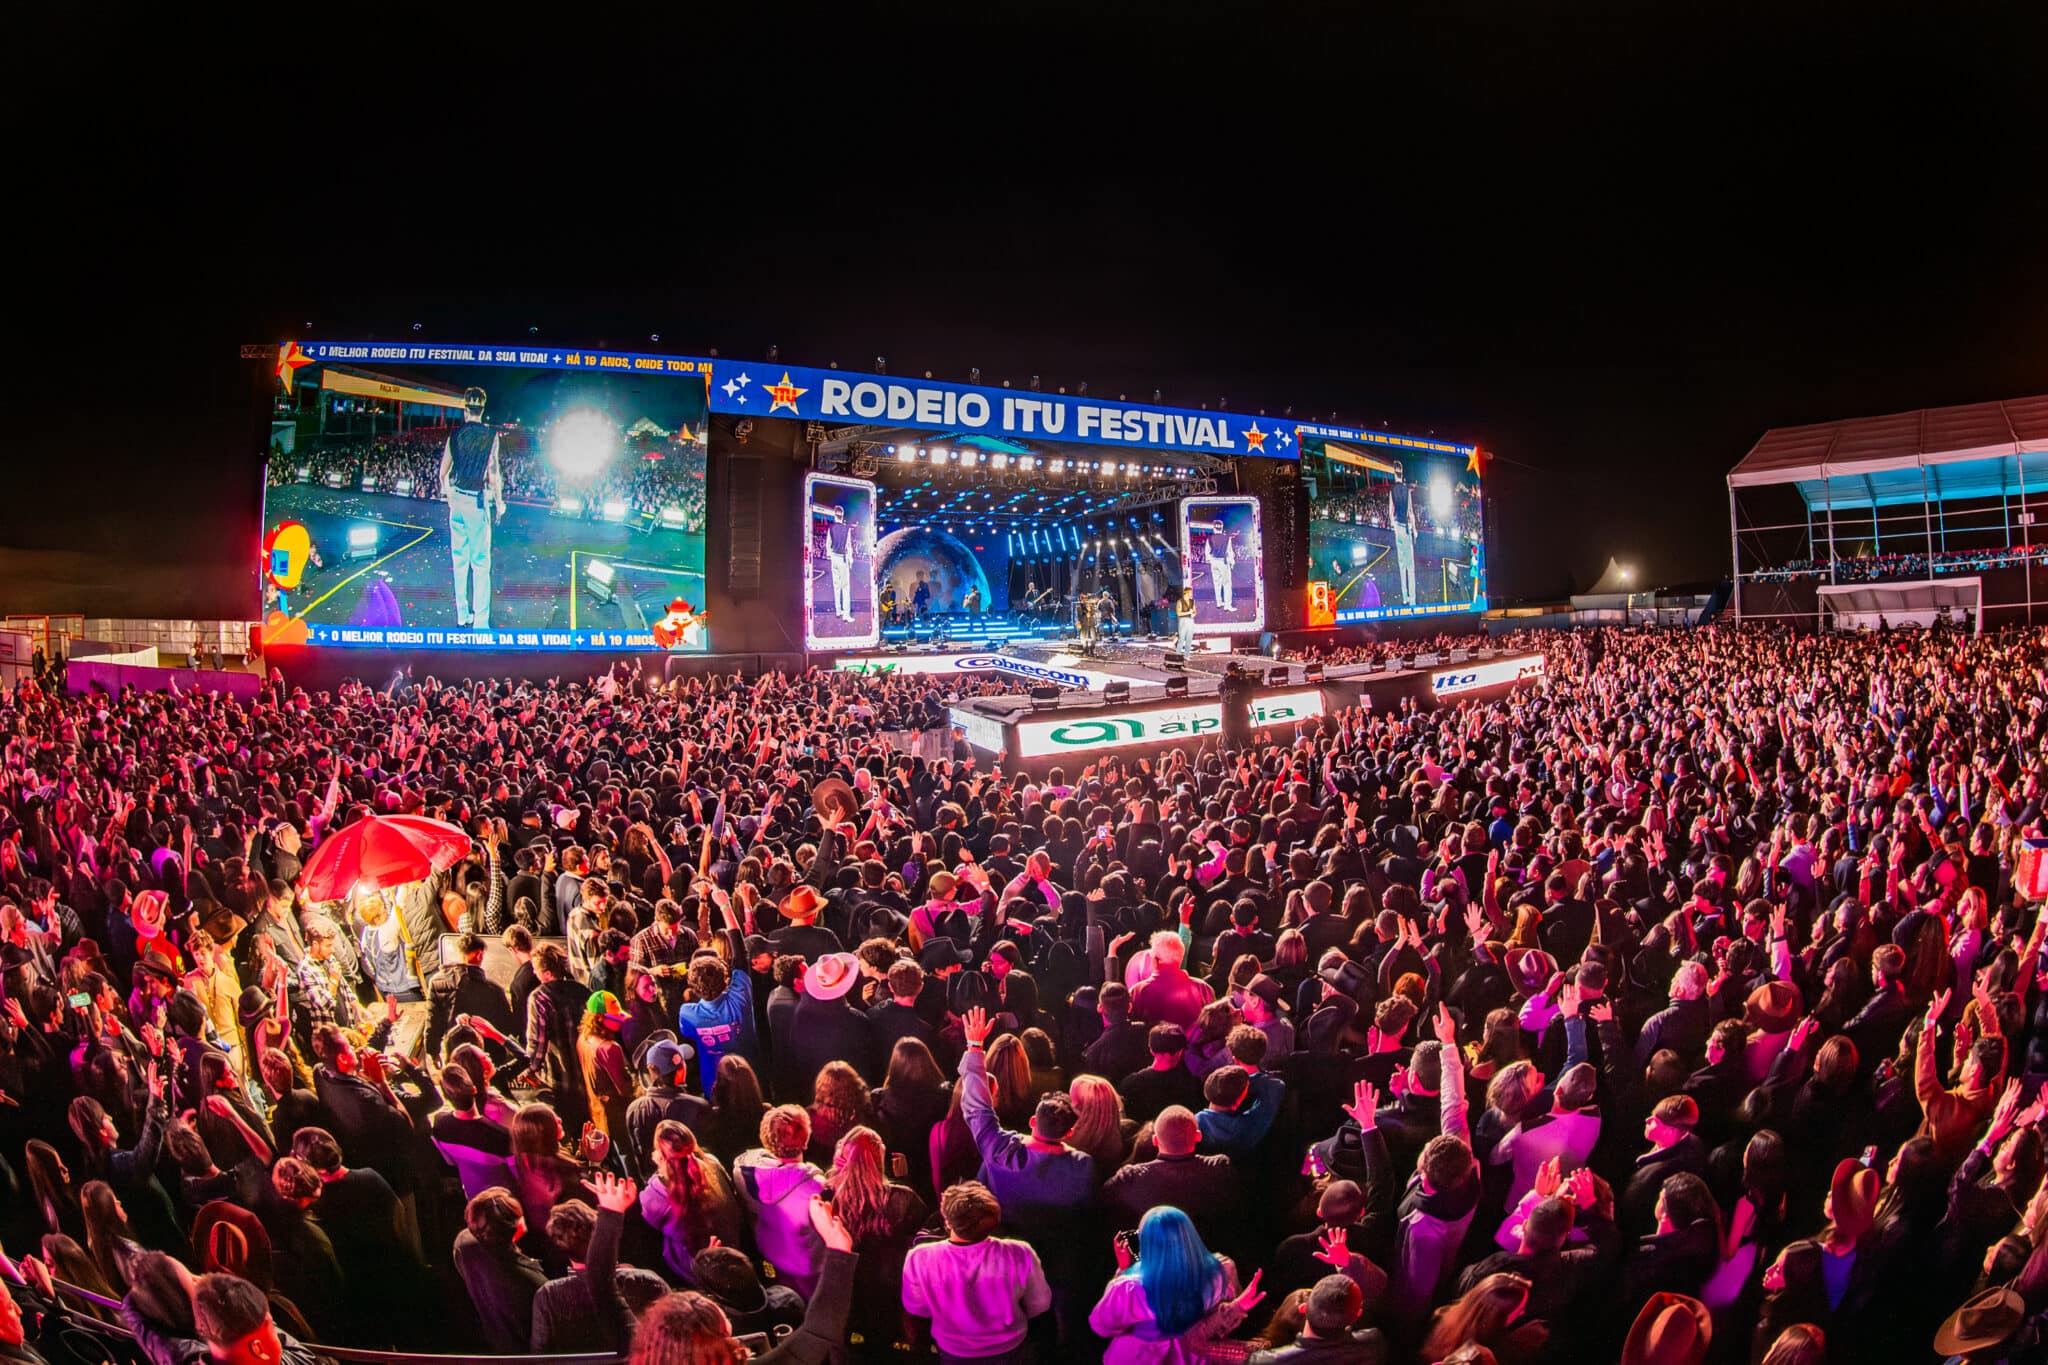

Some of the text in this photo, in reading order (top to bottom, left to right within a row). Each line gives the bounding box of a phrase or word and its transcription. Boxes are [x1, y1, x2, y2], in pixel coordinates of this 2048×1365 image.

[319, 346, 326, 356] O
[329, 346, 369, 358] MELHOR
[371, 347, 407, 359] RODEIO
[409, 348, 425, 359] ITU
[428, 348, 475, 361] FESTIVAL
[478, 350, 492, 361] DA
[496, 350, 516, 362] SUA
[520, 351, 548, 364] VIDA!
[566, 352, 581, 365] HÁ
[600, 356, 631, 369] ANOS,
[635, 358, 663, 370] ONDE
[667, 360, 694, 373] TODO
[820, 379, 1235, 449] RODEIO ITU FESTIVAL
[331, 630, 339, 642] O
[342, 631, 383, 643] MELHOR
[386, 631, 424, 643] RODEIO
[427, 631, 444, 644] ITU
[447, 631, 496, 645] FESTIVAL
[499, 633, 514, 645] DA
[517, 633, 539, 645] SUA
[542, 633, 571, 645] VIDA!
[955, 657, 1090, 687] Cobrecom
[1160, 706, 1296, 734] apia
